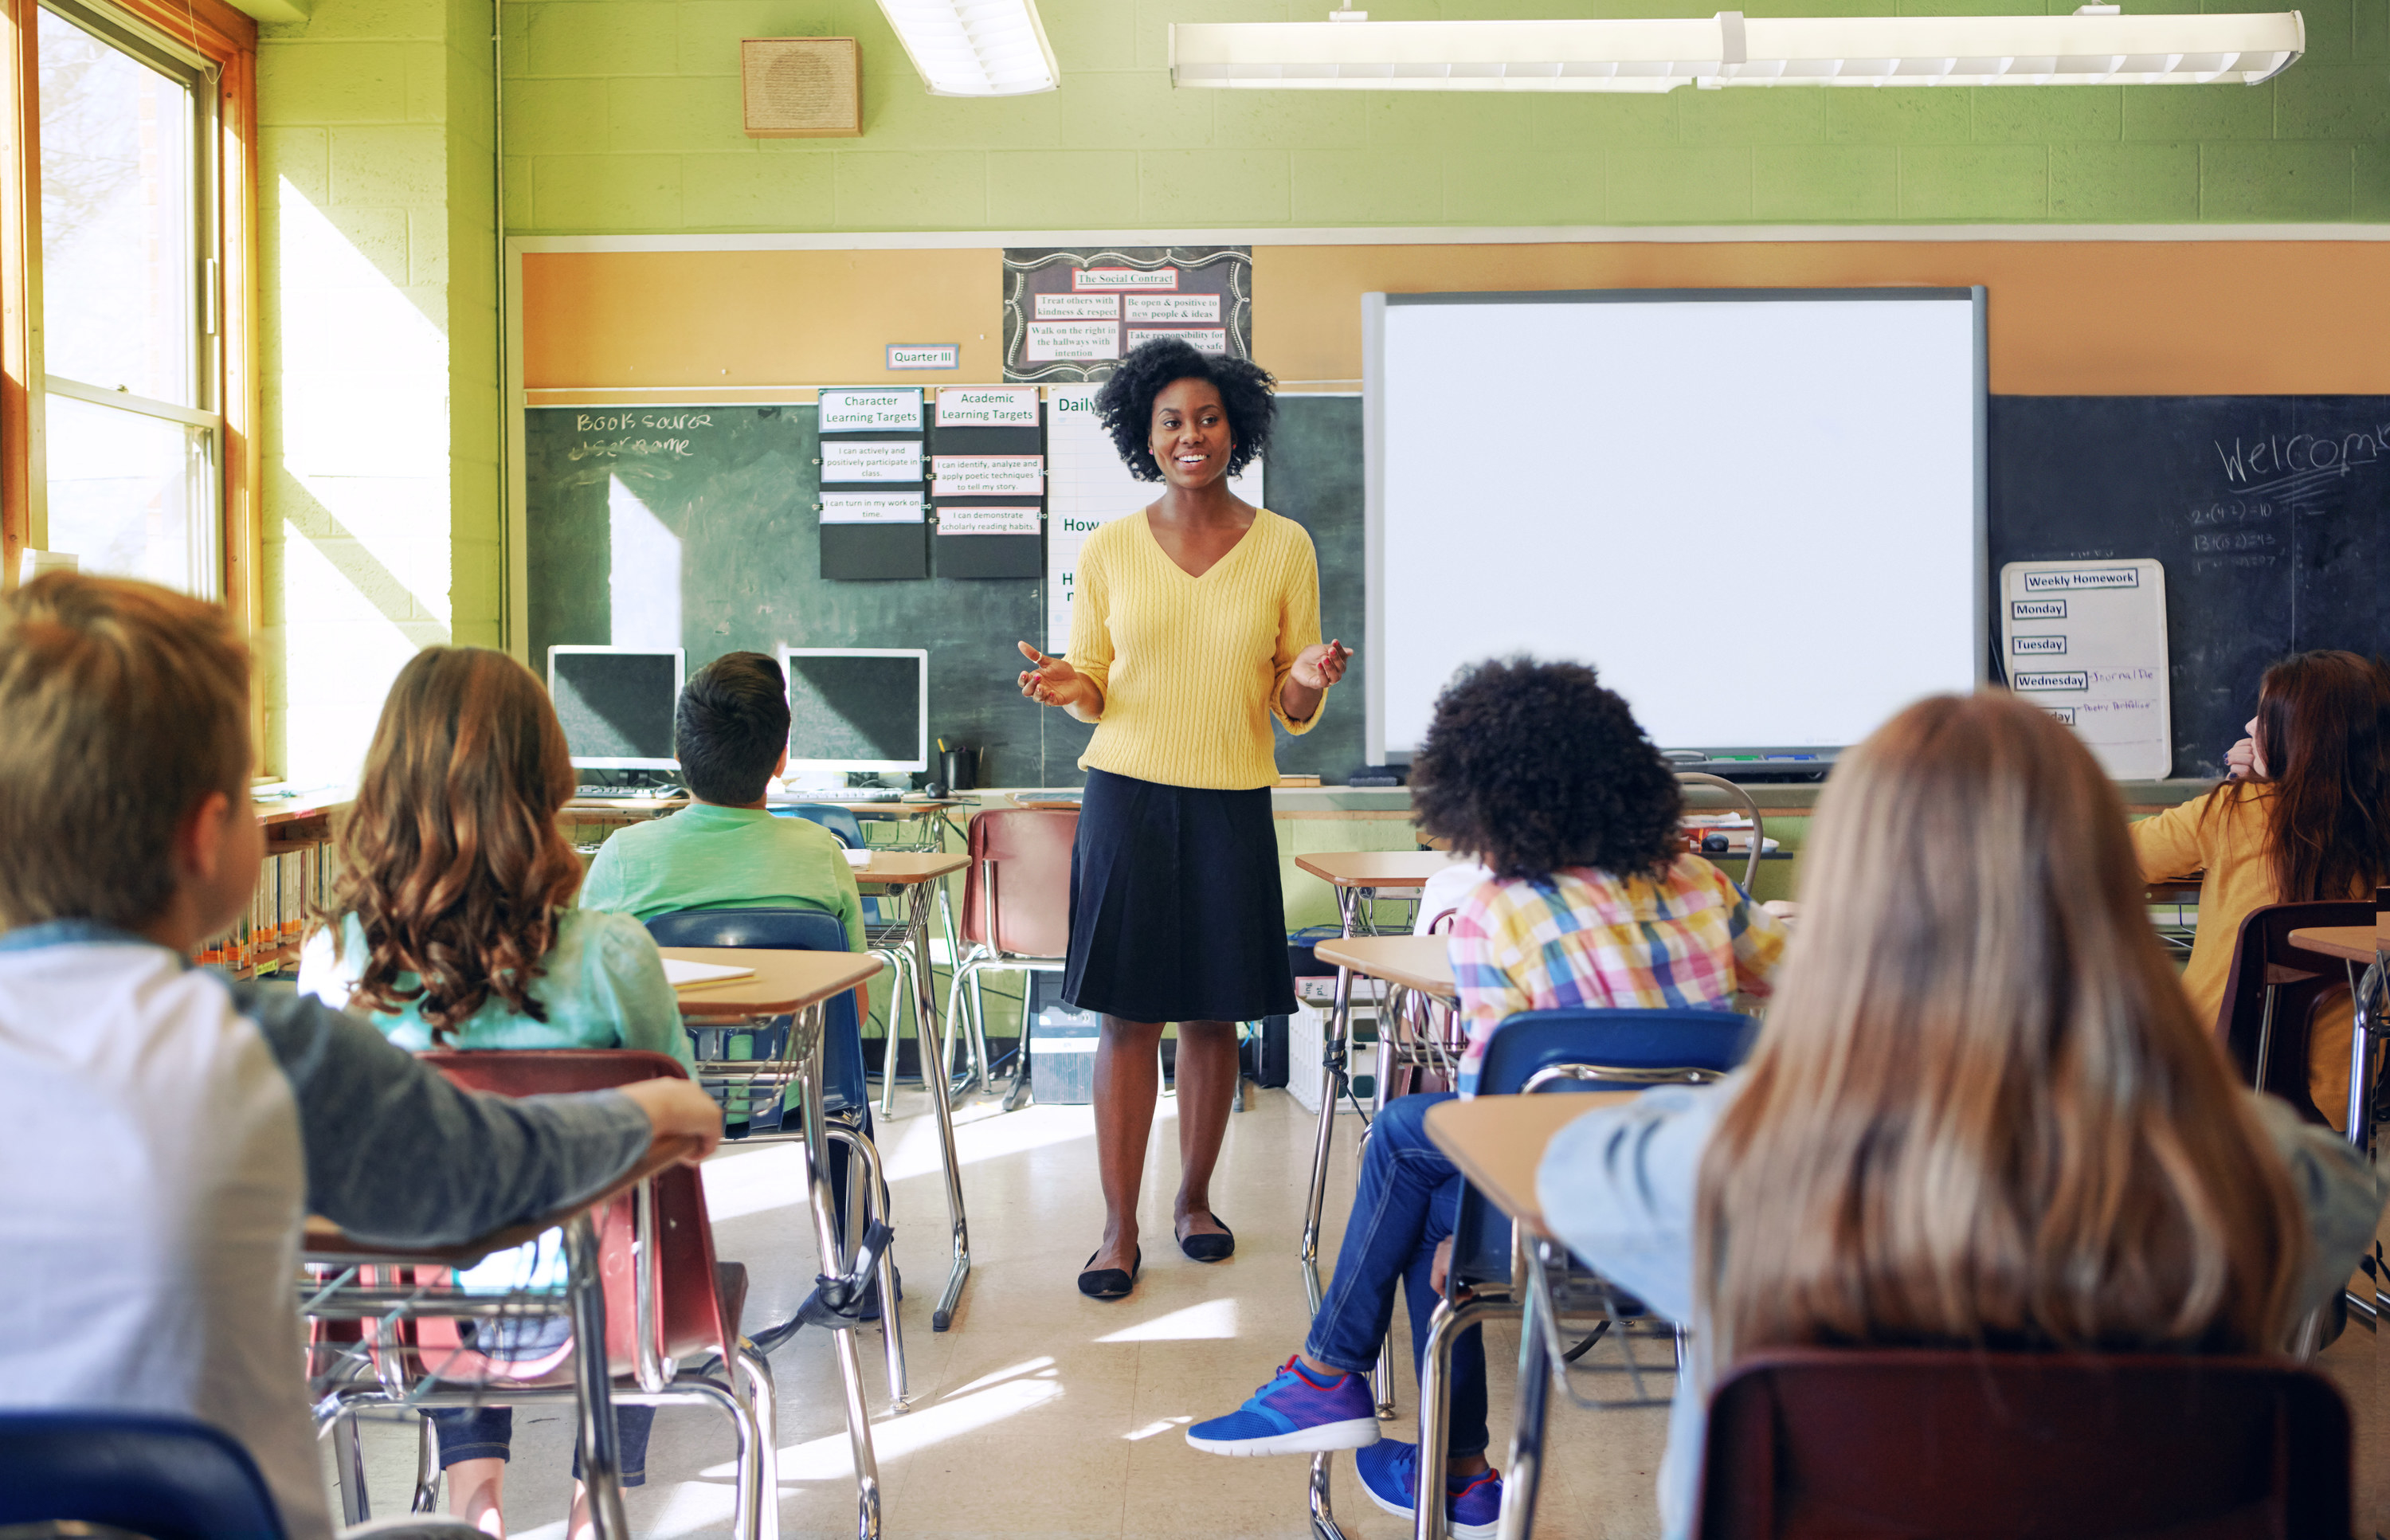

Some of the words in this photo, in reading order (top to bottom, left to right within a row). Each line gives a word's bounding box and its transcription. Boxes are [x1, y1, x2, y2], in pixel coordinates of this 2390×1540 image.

[1078, 274, 1097, 283] The
[1099, 274, 1127, 283] Social
[1130, 274, 1173, 283] Contract
[1174, 299, 1207, 308] positive
[1087, 308, 1117, 317] respect
[1151, 310, 1179, 319] people
[1085, 327, 1106, 335] right
[1153, 331, 1209, 340] responsibility
[1052, 338, 1090, 347] hallways
[895, 352, 938, 362] Quarter
[941, 352, 951, 362] III
[844, 396, 898, 406] Character
[961, 393, 1014, 403] Academic
[1059, 398, 1096, 415] Daily
[826, 412, 873, 424] Learning
[876, 412, 917, 423] Targets
[942, 409, 989, 421] Learning
[993, 409, 1032, 421] Targets
[957, 460, 989, 469] identify,
[1064, 518, 1099, 531] How
[2029, 574, 2070, 588] Weekly
[2073, 572, 2134, 584] Homework
[2016, 603, 2063, 615] Monday
[2016, 638, 2063, 650] Tuesday
[2018, 676, 2084, 688] Wednesday
